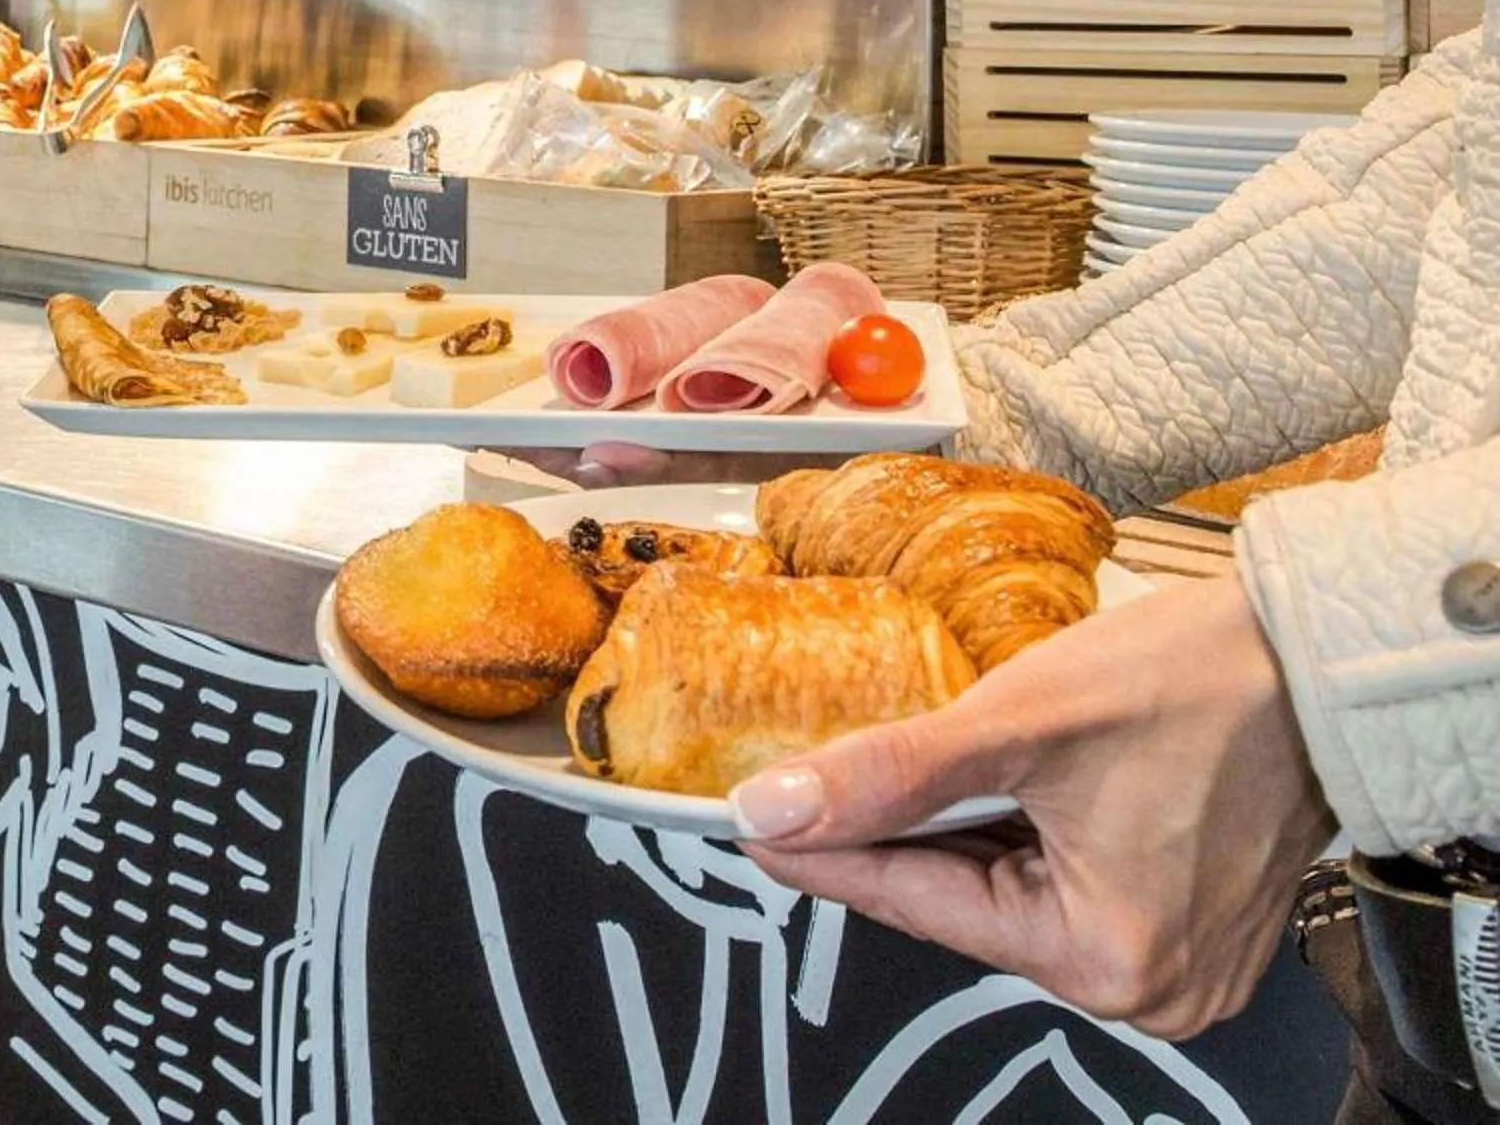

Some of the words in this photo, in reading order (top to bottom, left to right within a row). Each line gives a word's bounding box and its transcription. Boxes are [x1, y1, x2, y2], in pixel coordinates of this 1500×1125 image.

[164, 176, 199, 204] ibis
[202, 177, 274, 213] kitchen
[382, 193, 428, 232] SANS
[352, 227, 461, 267] GLUTEN
